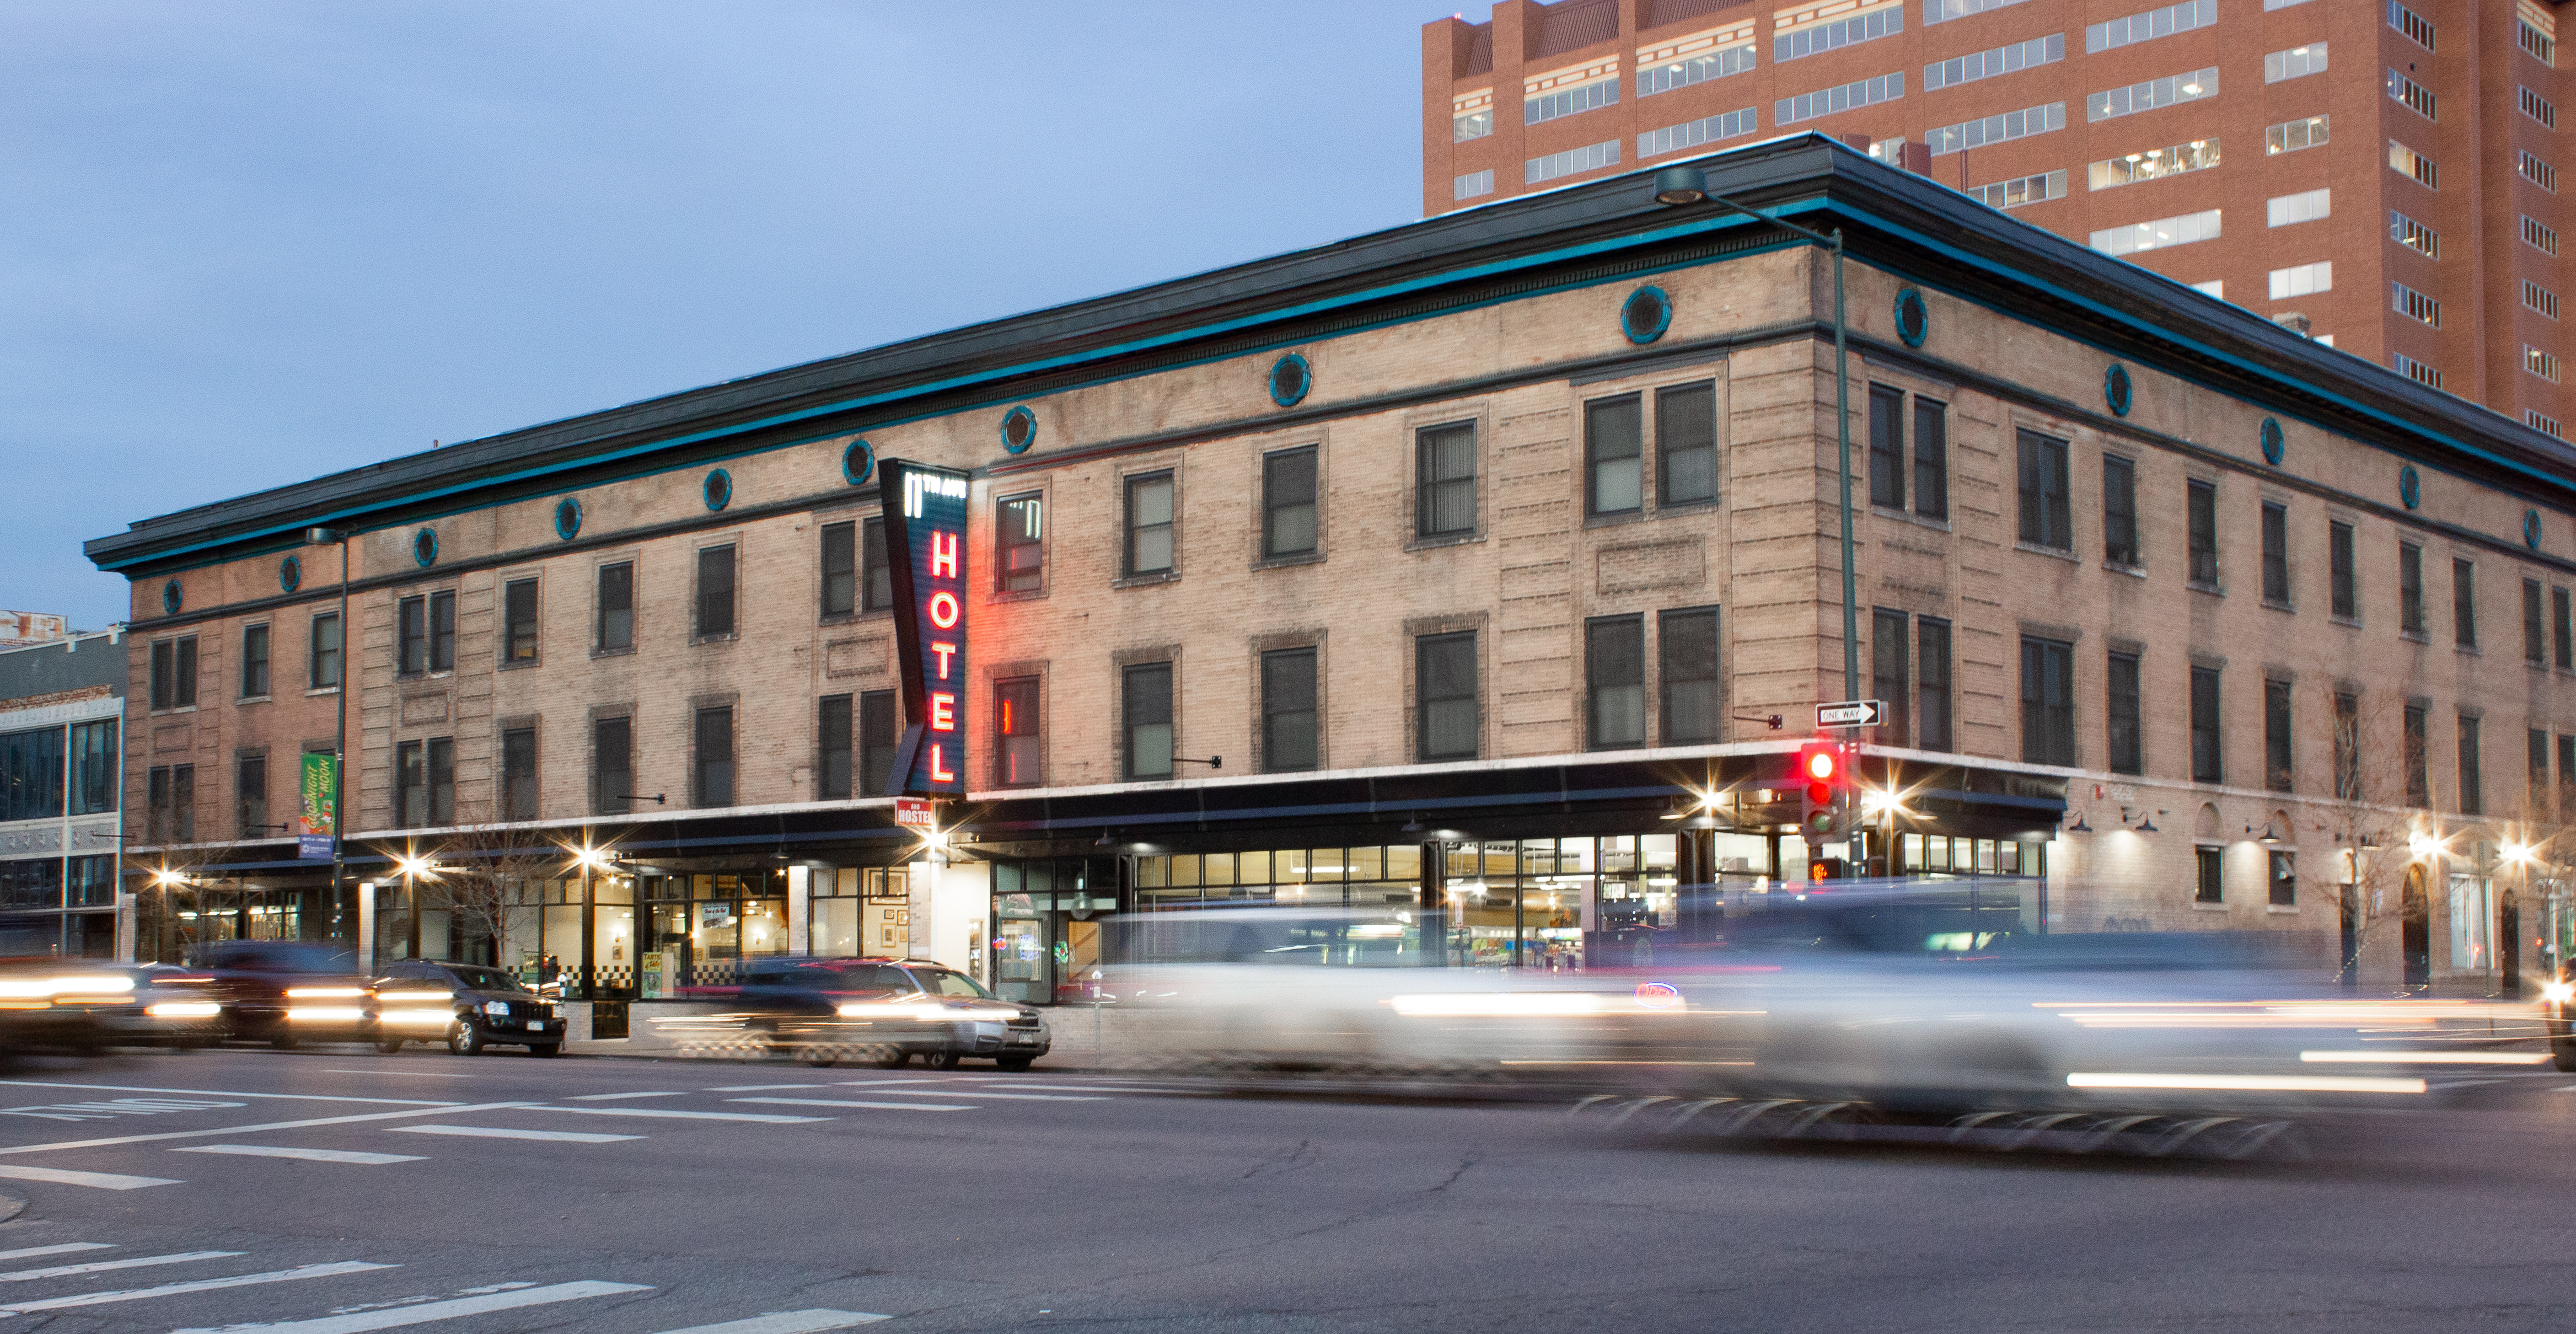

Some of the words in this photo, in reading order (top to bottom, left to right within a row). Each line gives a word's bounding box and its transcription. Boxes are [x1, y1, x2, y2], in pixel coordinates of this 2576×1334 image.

[930, 531, 958, 782] HOTEL
[1823, 710, 1839, 720] ONE
[1843, 709, 1859, 719] WAY
[319, 759, 330, 792] MOON
[306, 763, 319, 829] GOODNIGHT
[898, 810, 932, 824] HOSTEL
